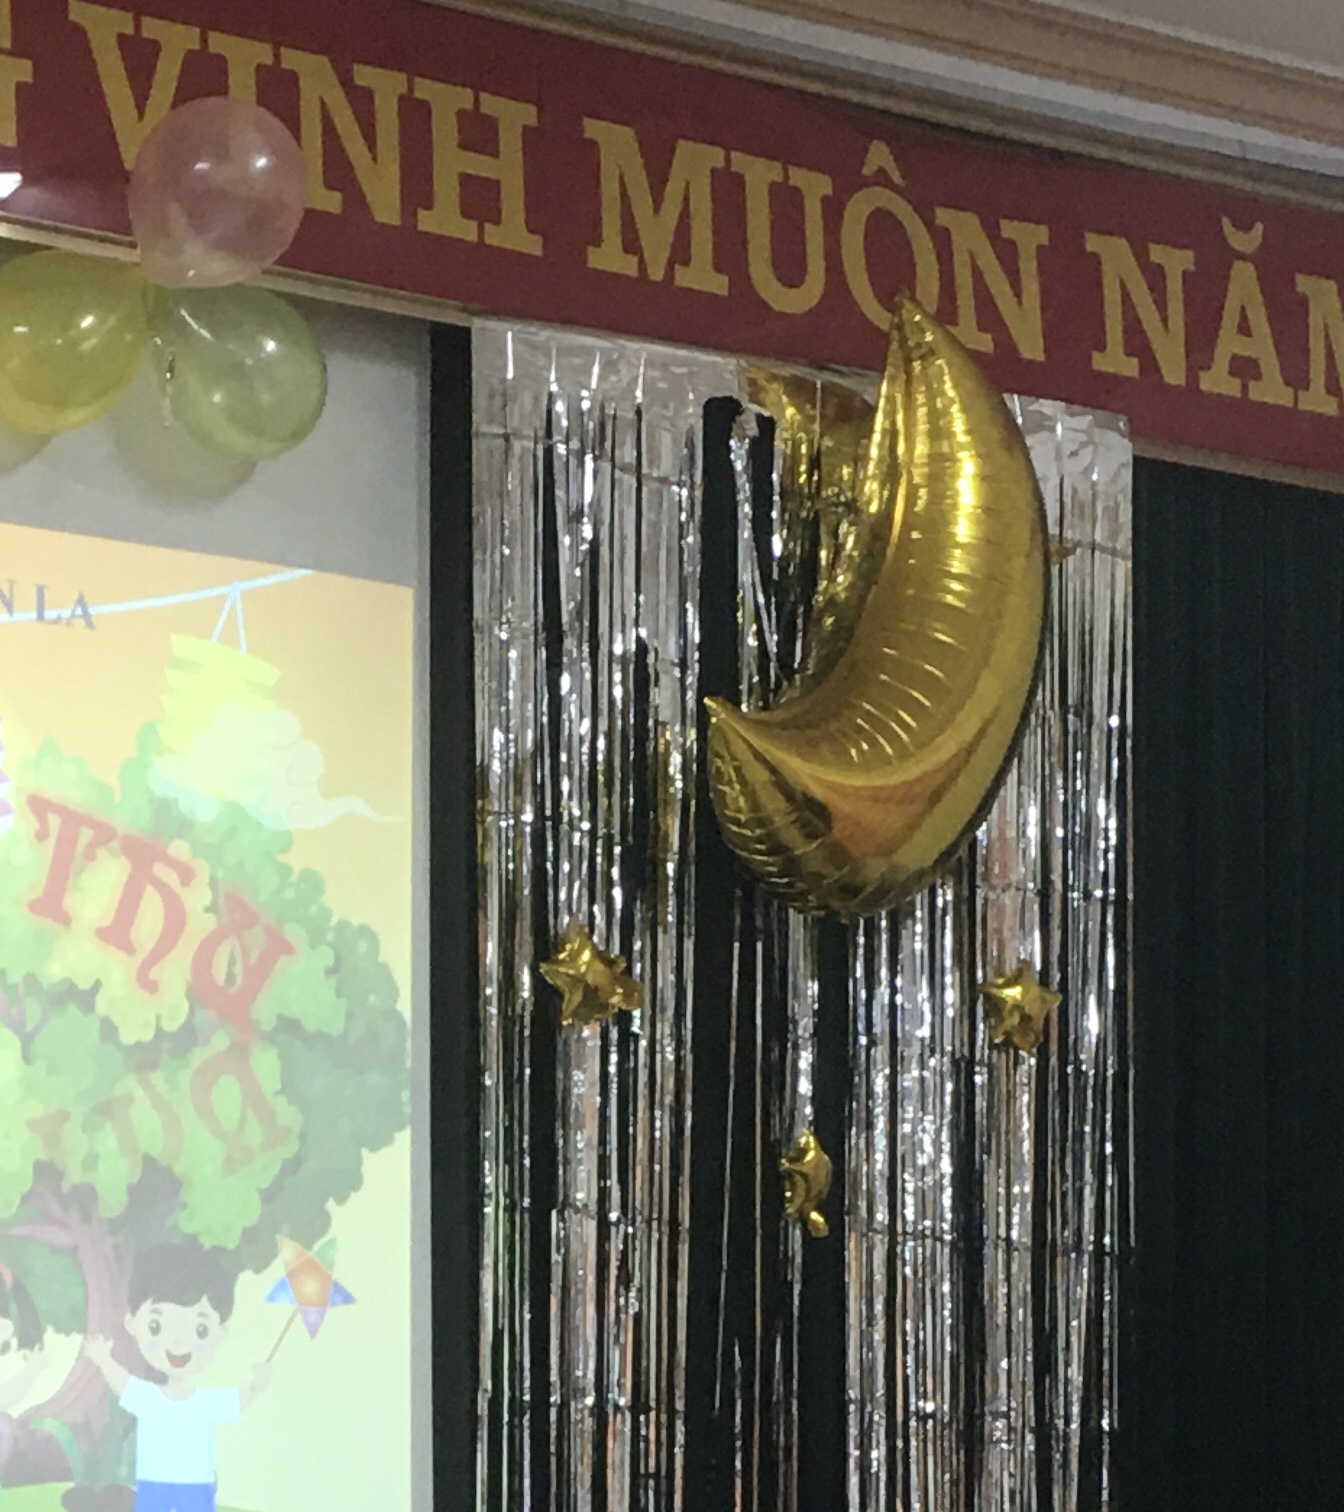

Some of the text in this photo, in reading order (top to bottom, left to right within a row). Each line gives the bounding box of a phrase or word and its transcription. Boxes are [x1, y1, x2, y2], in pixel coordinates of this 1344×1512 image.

[583, 116, 1049, 361] MUÔN
[35, 583, 96, 630] LA
[25, 793, 297, 1037] THU
